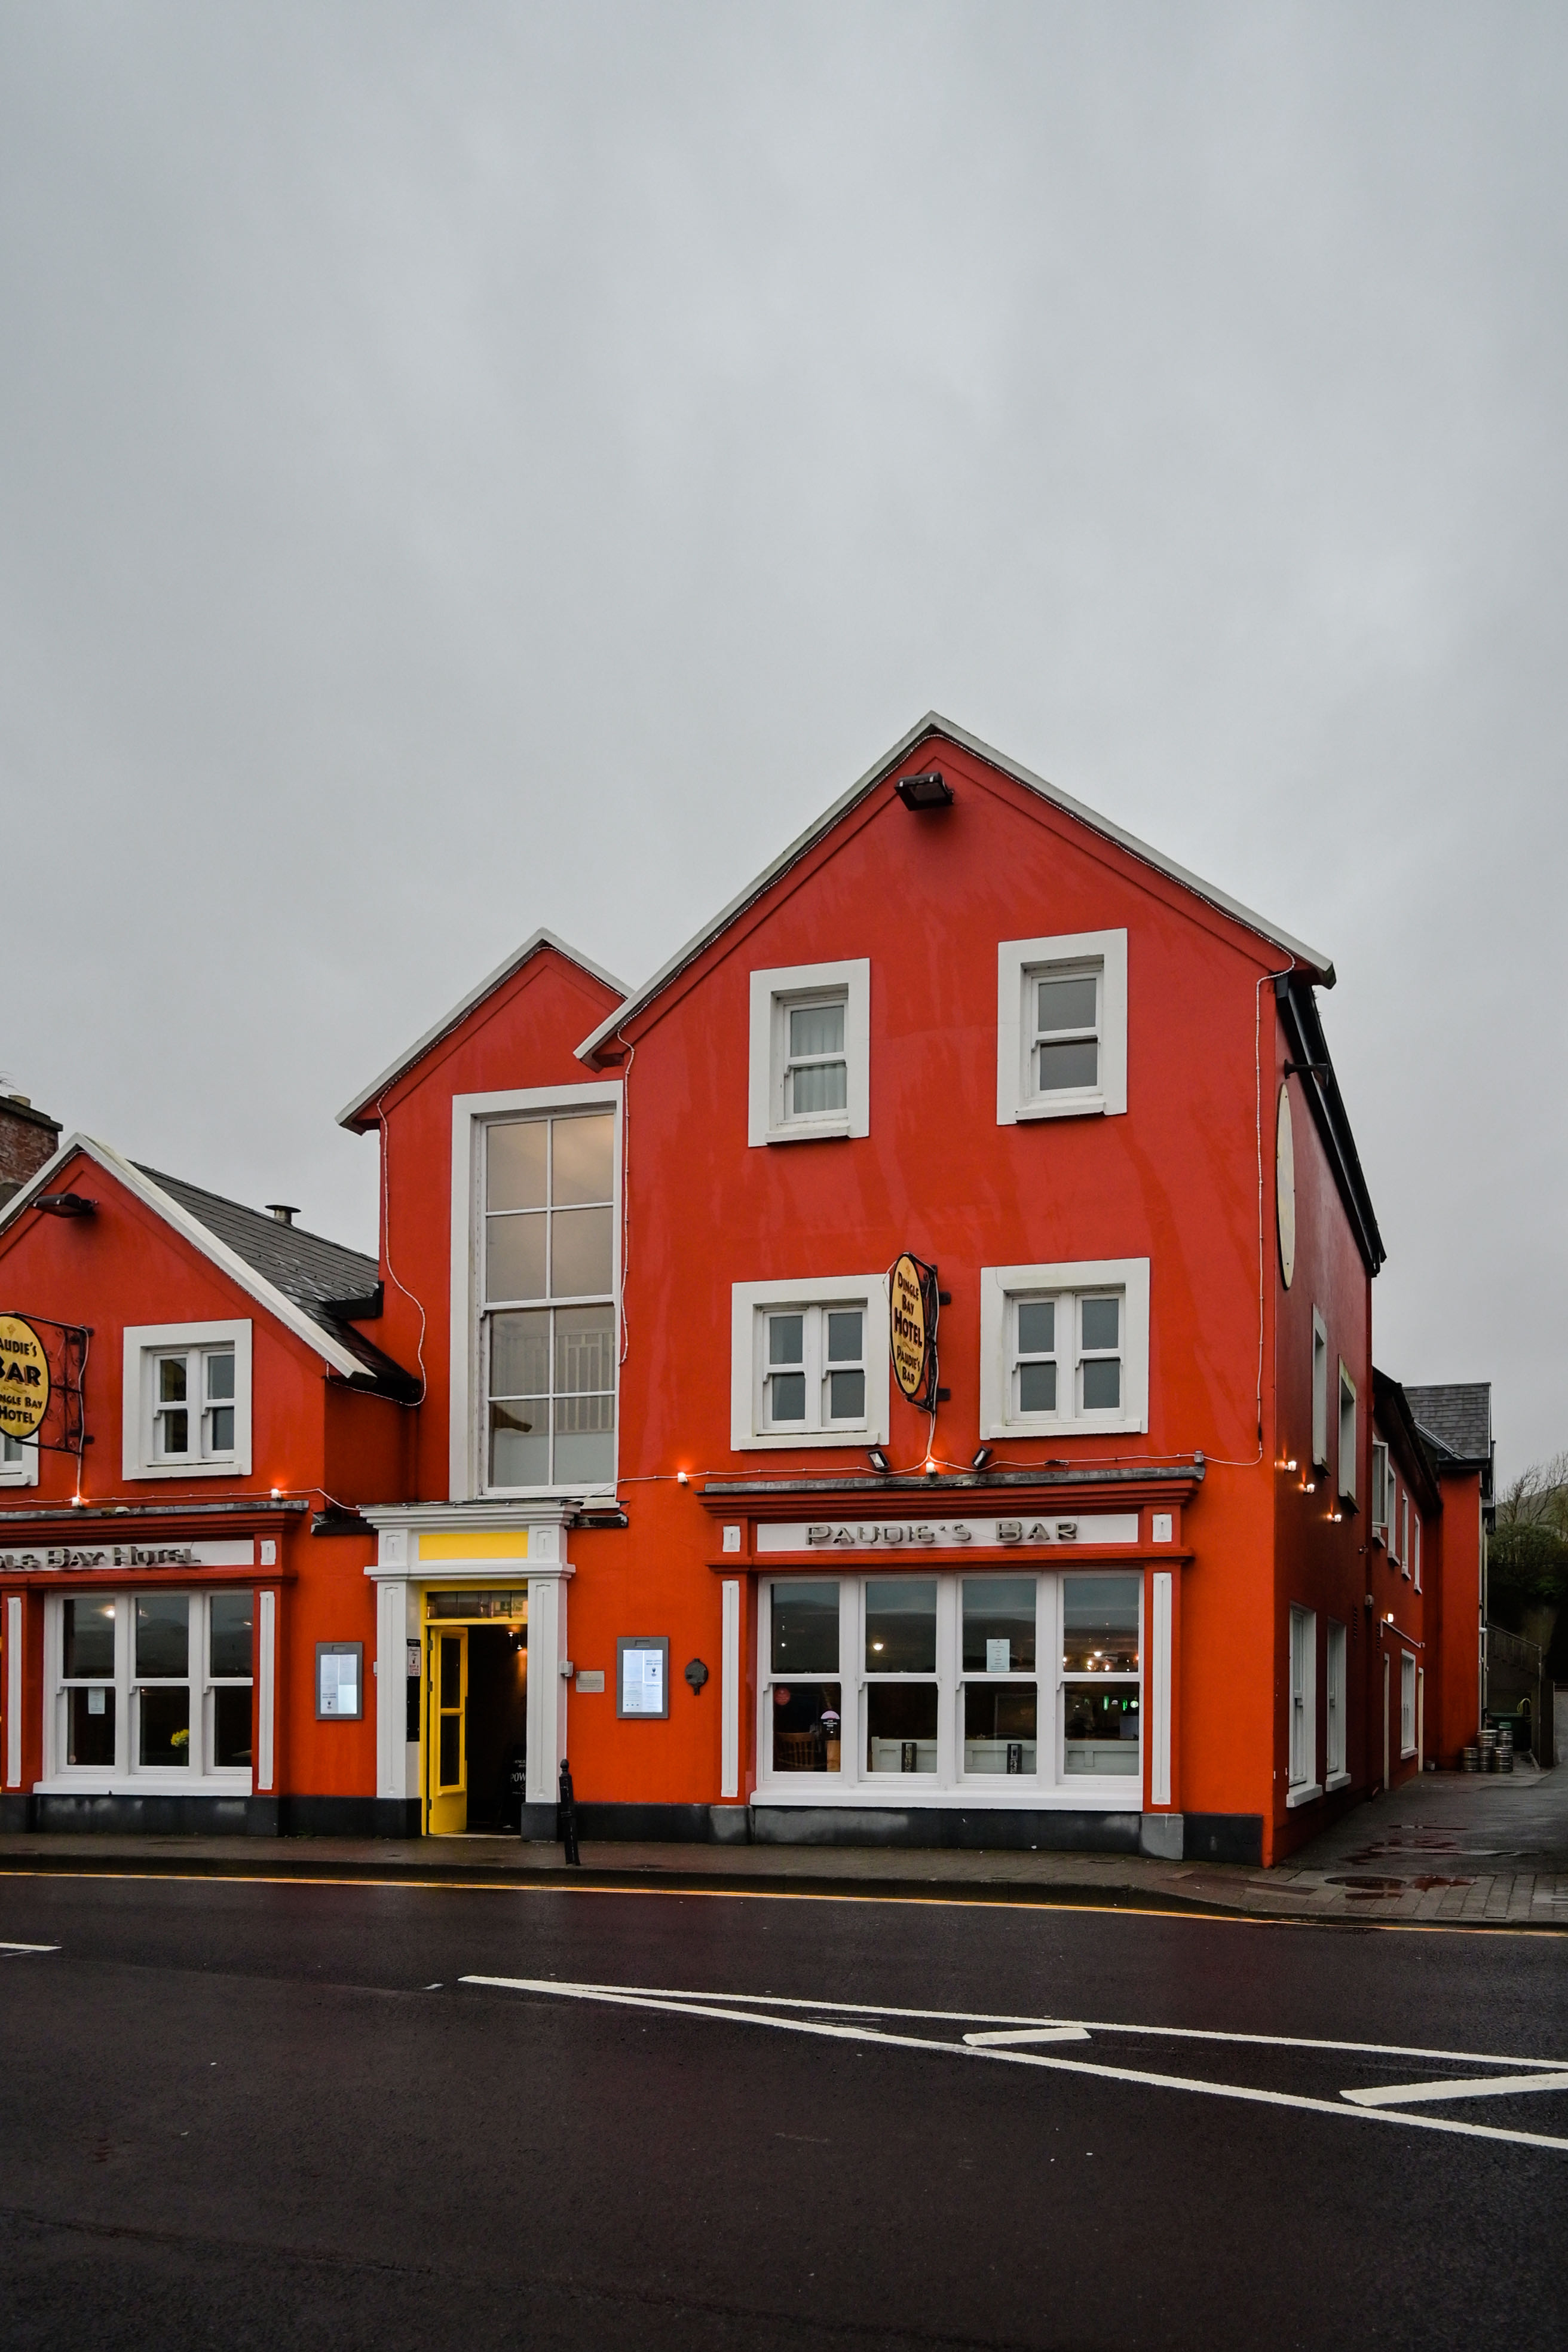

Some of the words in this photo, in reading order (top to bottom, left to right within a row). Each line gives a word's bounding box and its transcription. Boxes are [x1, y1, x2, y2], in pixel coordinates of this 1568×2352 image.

[898, 1272, 919, 1301] DINGLE
[902, 1294, 914, 1316] BAY
[894, 1307, 923, 1348] HOTEL
[897, 1345, 920, 1372] PAUDIE'S
[902, 1366, 915, 1385] BAR
[24, 1396, 42, 1409] BAY
[0, 1405, 35, 1425] HOTEL
[806, 1523, 972, 1545] PAUDIE'S
[996, 1520, 1078, 1542] BAR
[46, 1548, 106, 1567] BAY
[112, 1545, 201, 1566] HOTEL
